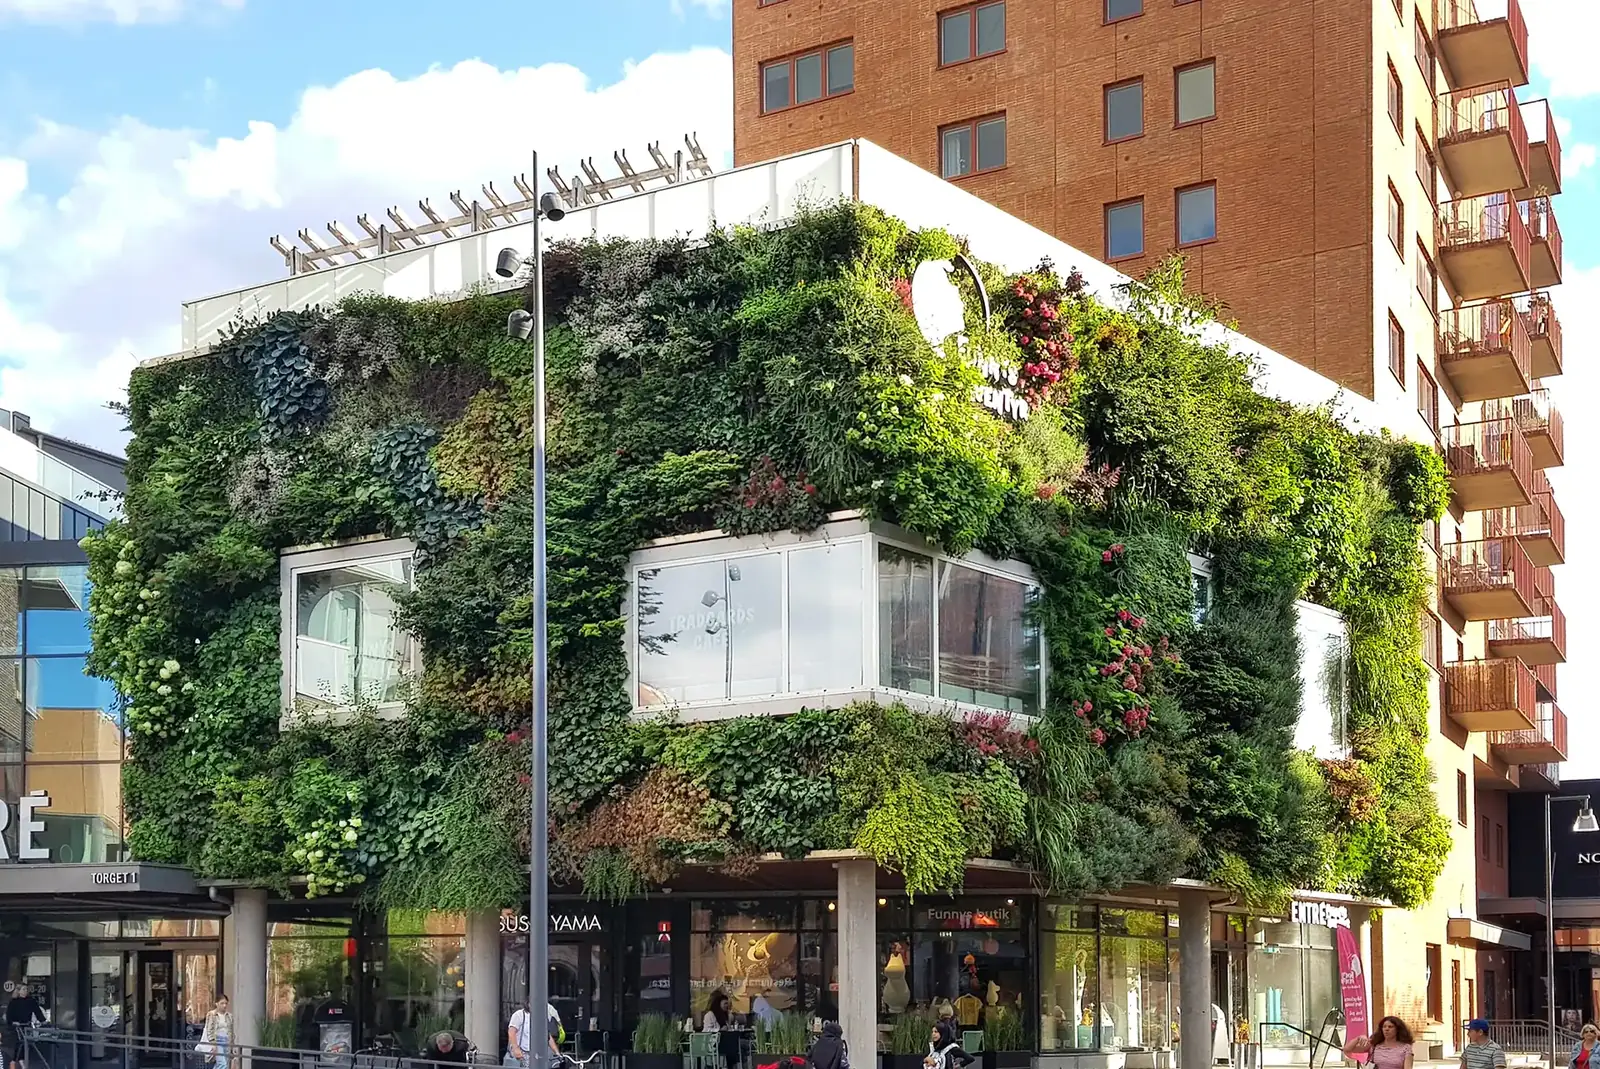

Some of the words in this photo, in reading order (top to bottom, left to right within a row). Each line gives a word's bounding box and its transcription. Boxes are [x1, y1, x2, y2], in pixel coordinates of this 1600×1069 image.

[91, 873, 128, 884] TORGET
[131, 873, 137, 883] 1
[976, 908, 1010, 920] butik
[500, 915, 531, 931] SUS
[551, 915, 601, 931] YAMA
